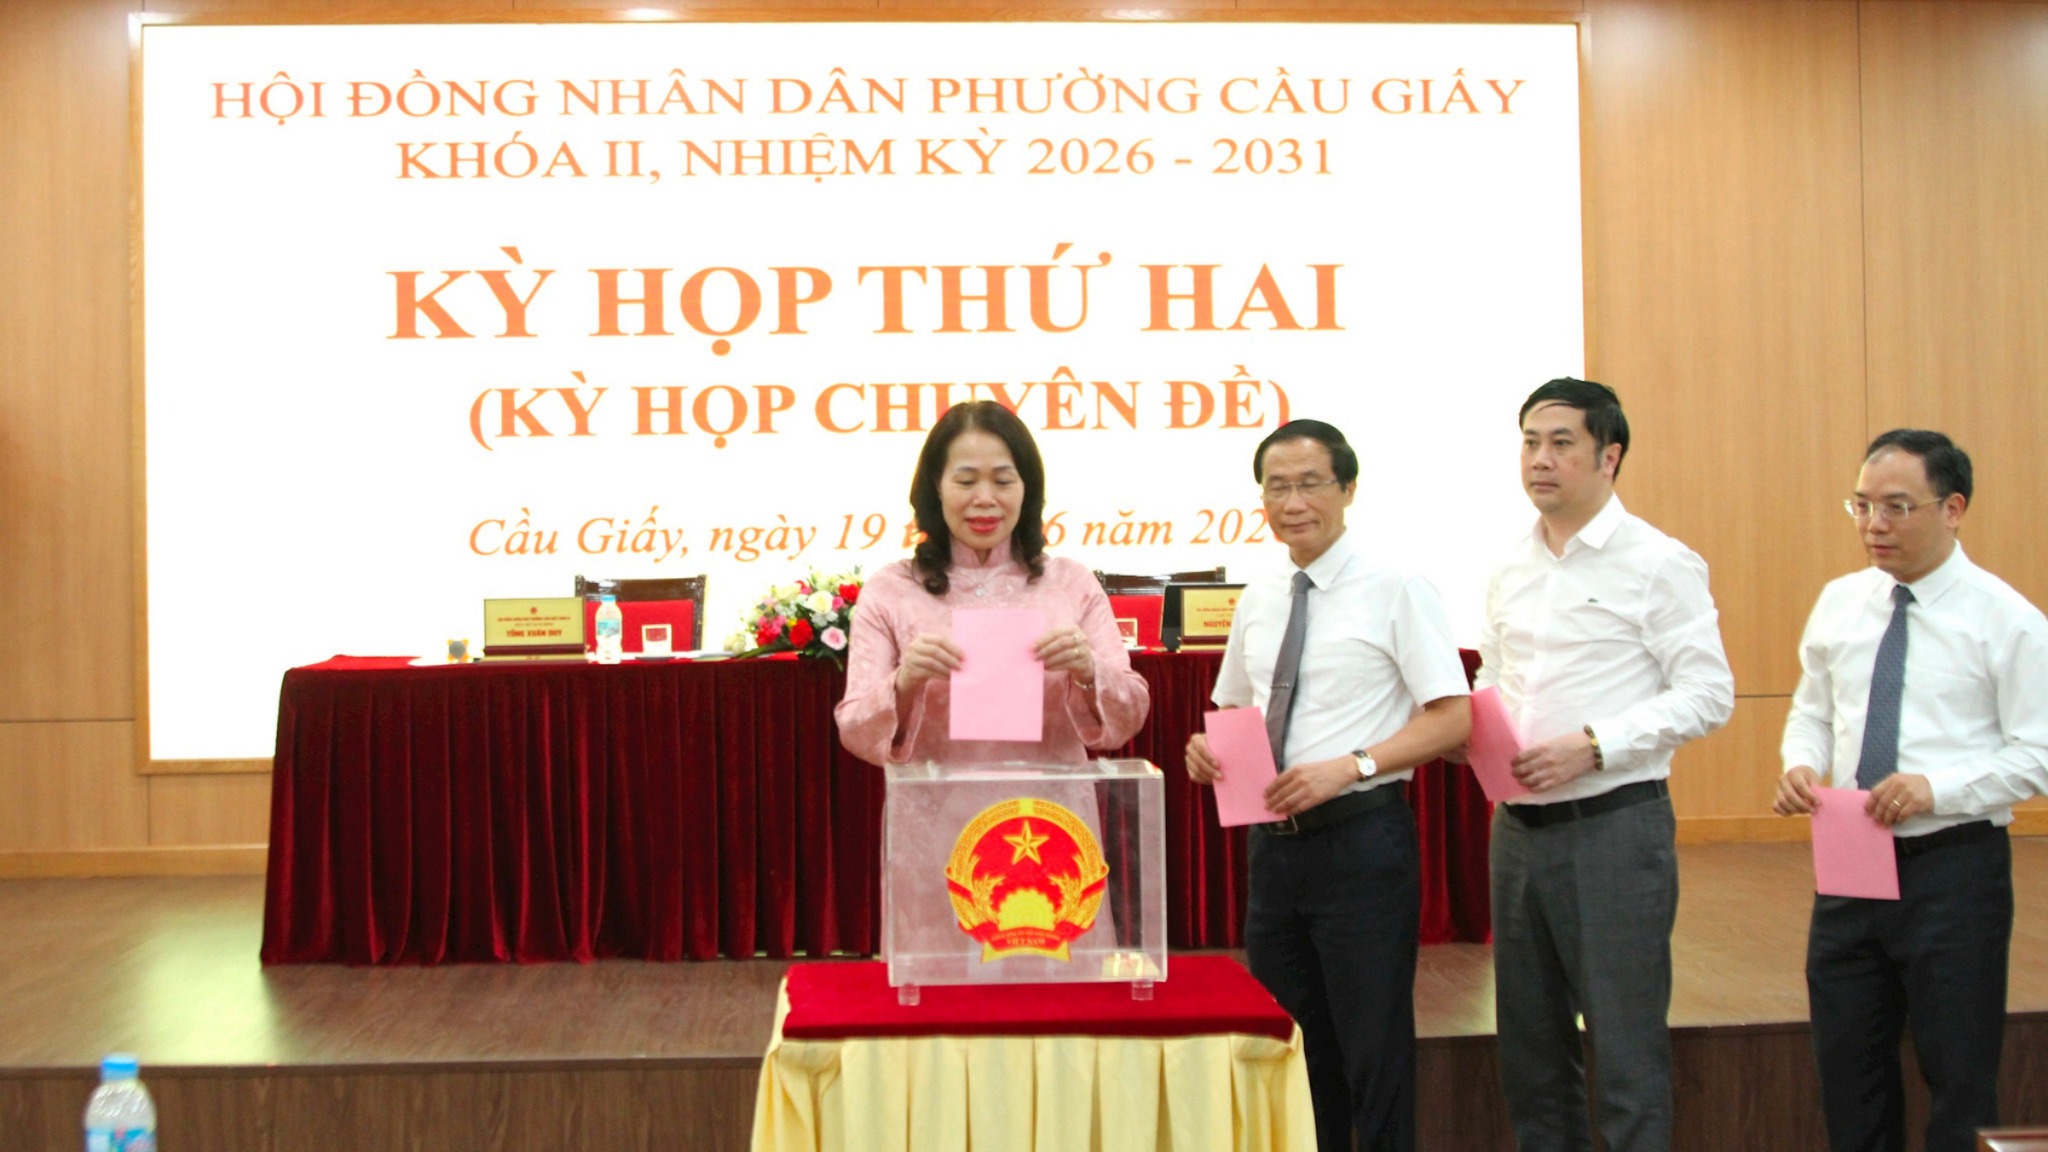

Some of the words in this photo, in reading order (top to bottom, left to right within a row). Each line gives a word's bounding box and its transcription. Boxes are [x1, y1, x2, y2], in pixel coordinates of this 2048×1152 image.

[211, 71, 326, 126] HỘI
[347, 69, 539, 118] ĐỒNG
[557, 68, 746, 116] NHÂN
[768, 67, 907, 114] DÂN
[928, 66, 1200, 114] PHƯỜNG
[1219, 66, 1350, 115] CẦU
[1371, 67, 1525, 114] GIẤY
[396, 130, 587, 179] KHÓA
[604, 140, 661, 184] II,
[681, 132, 896, 184] NHIỆM
[916, 126, 1007, 175] KỲ
[1028, 138, 1155, 175] 2026
[1212, 138, 1331, 175] 2031
[386, 245, 556, 340] KỲ
[587, 266, 833, 357] HỌP
[857, 242, 1113, 334] THỨ
[1139, 263, 1345, 332] HAI
[469, 370, 608, 451] (KỲ
[631, 384, 796, 449] HỌP
[1164, 364, 1291, 430] ĐỀ)
[469, 507, 558, 556] Cầu
[577, 505, 688, 564] Giấy,
[709, 514, 817, 563] ngày
[835, 513, 887, 550] 19
[1040, 510, 1068, 548] 6
[1082, 510, 1173, 546] năm
[1188, 508, 1285, 546] 202
